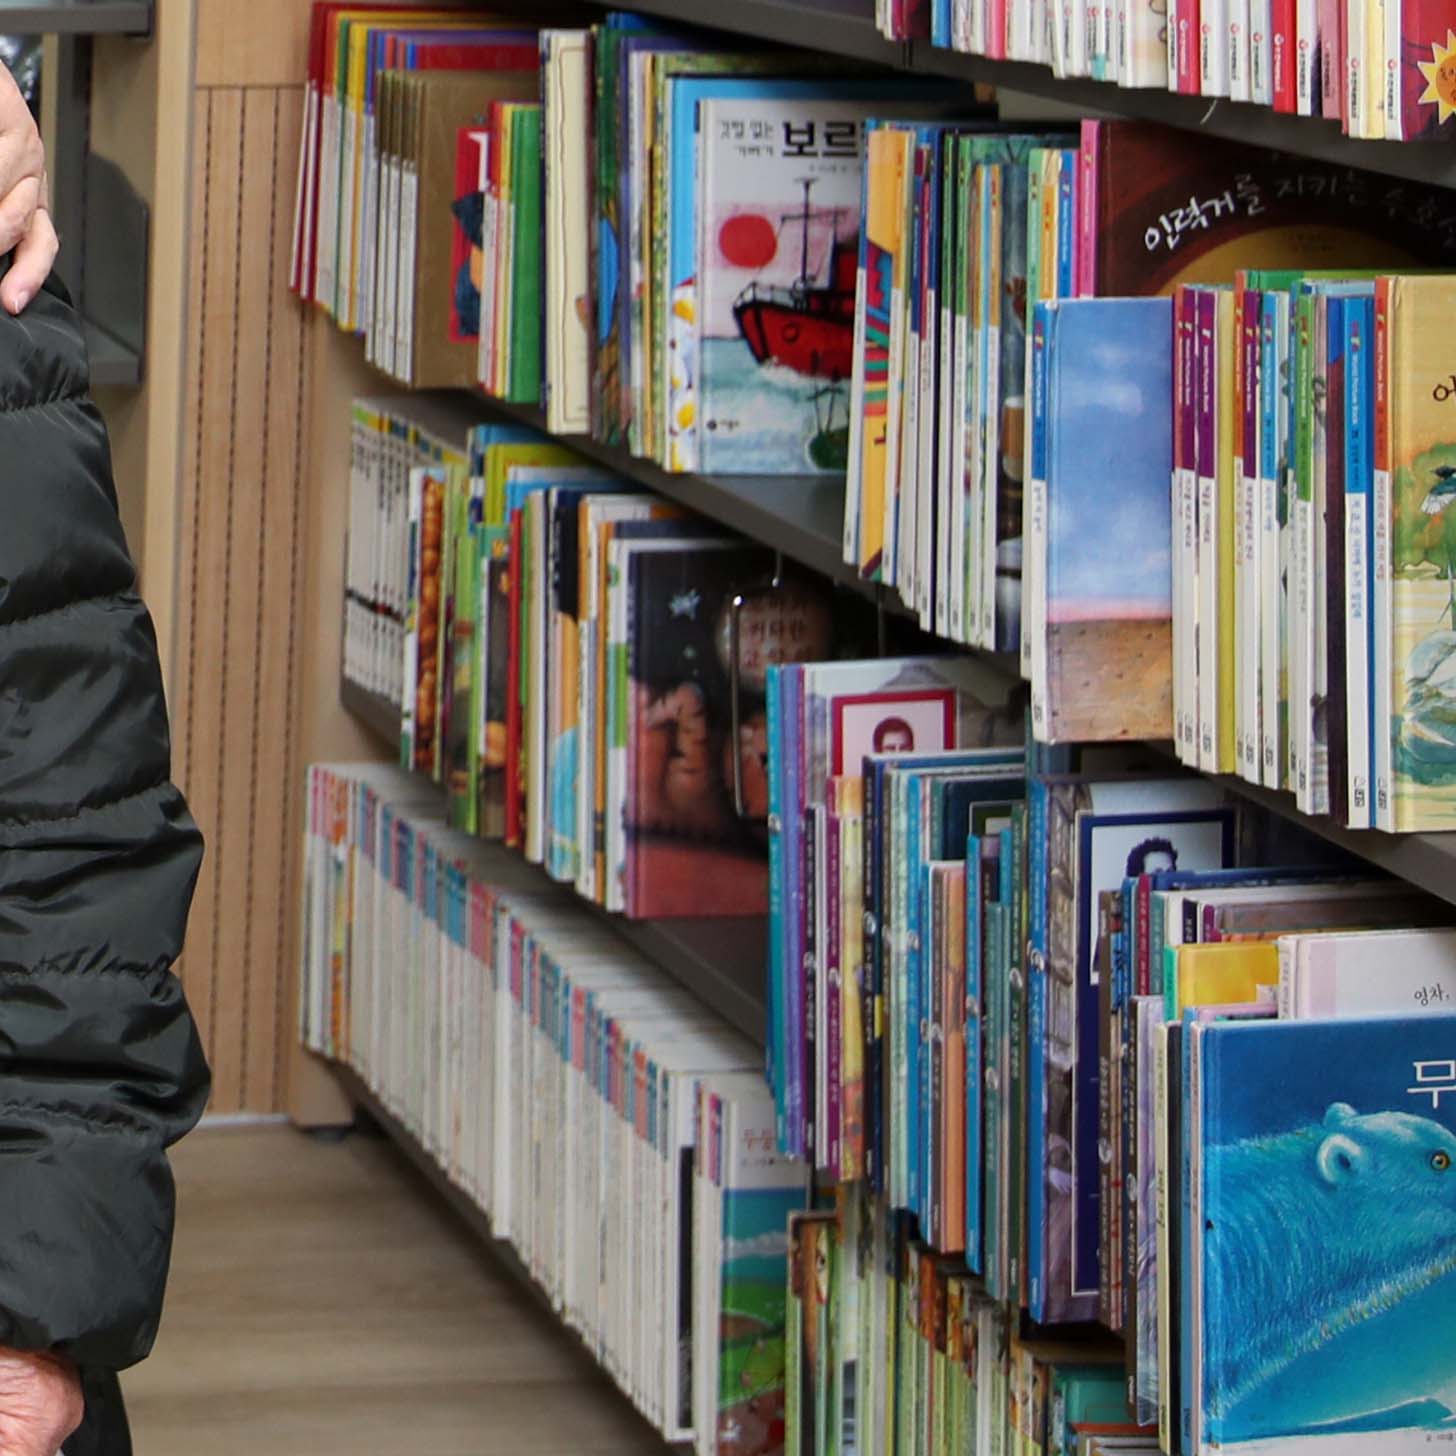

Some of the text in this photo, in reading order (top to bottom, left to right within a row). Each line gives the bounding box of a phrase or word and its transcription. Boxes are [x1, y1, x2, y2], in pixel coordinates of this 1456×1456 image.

[782, 120, 867, 158] 보르
[1143, 172, 1266, 252] 인력거를
[1406, 1059, 1456, 1109] 무
